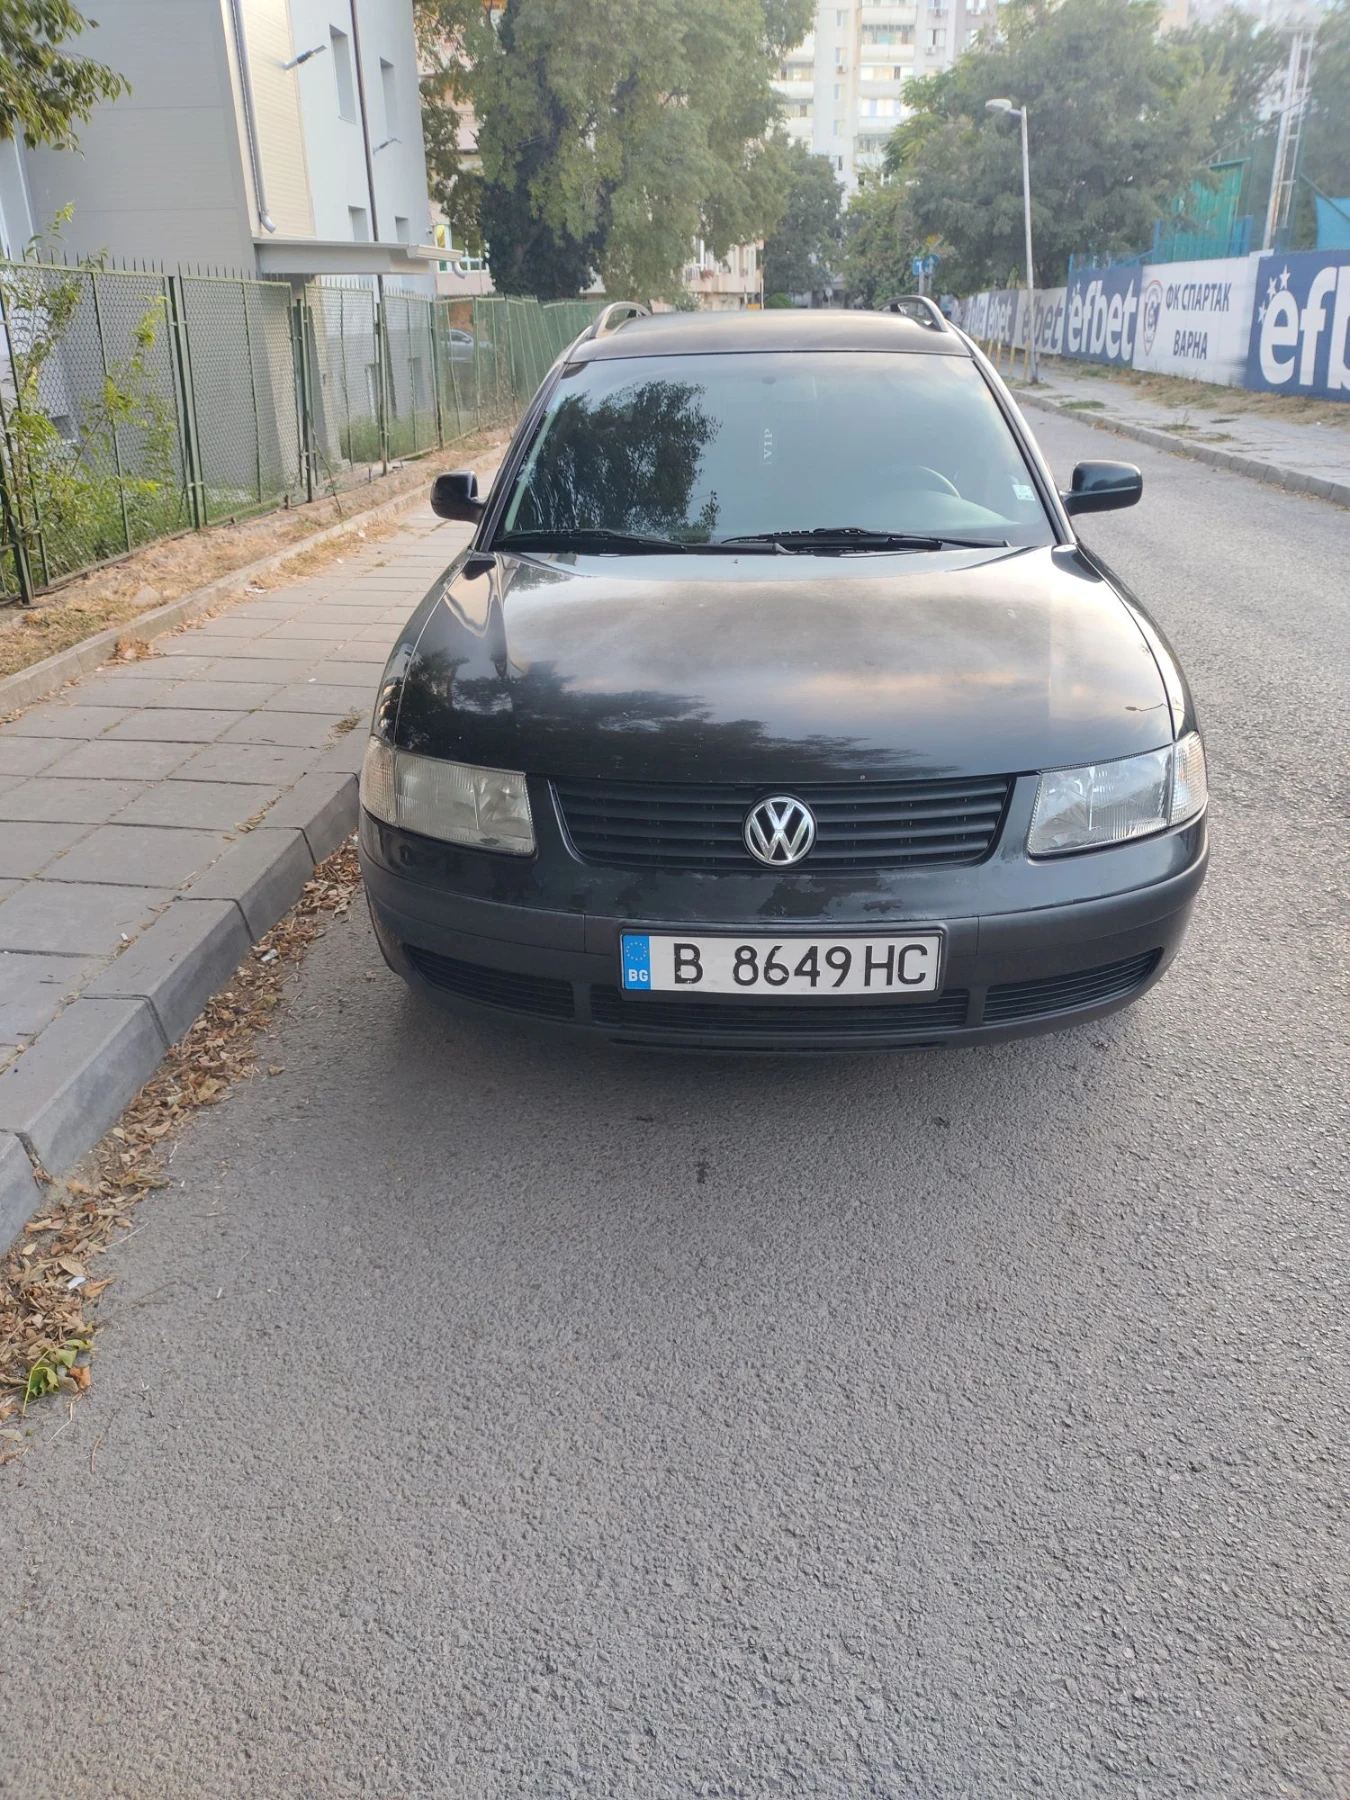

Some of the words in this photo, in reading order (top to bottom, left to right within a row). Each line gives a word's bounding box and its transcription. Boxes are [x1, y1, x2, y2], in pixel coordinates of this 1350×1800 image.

[1166, 283, 1181, 310] ФК
[1182, 283, 1232, 312] СПАРТАК
[1068, 279, 1137, 360] efbet
[1173, 329, 1208, 360] ВАРНА
[628, 968, 649, 982] BG
[674, 943, 703, 984] B
